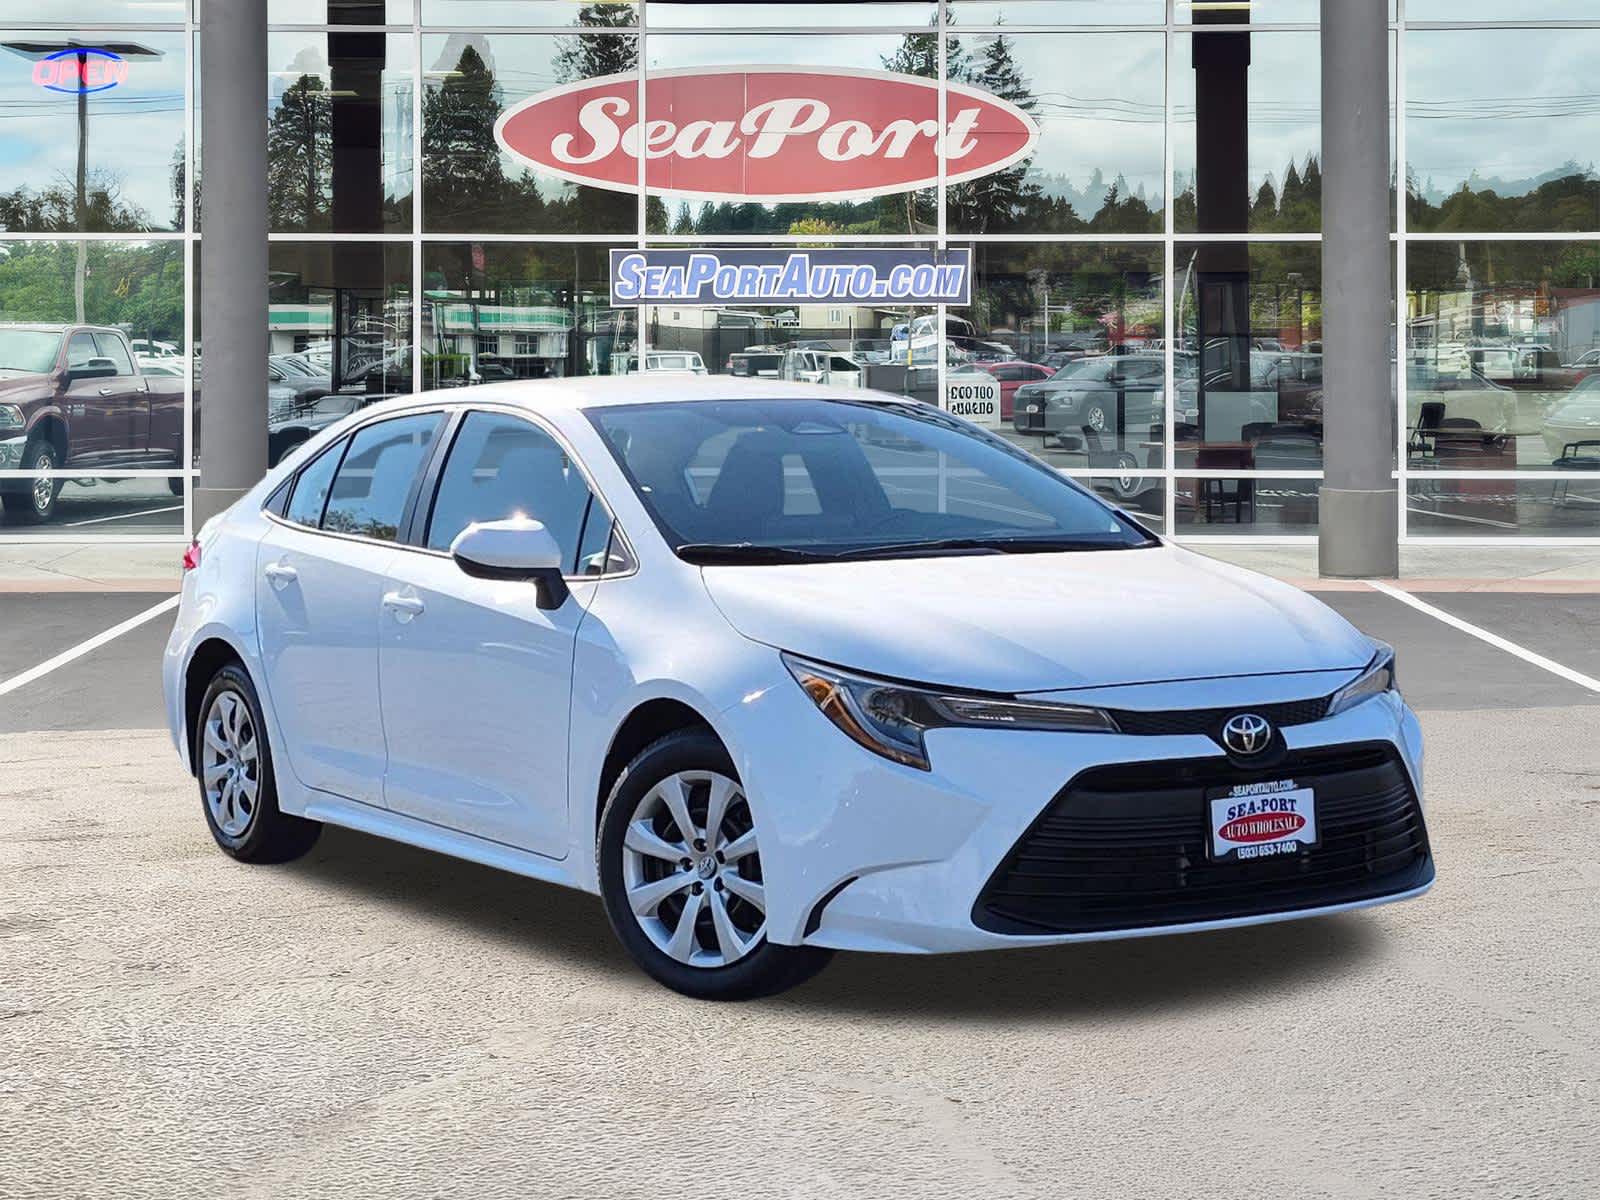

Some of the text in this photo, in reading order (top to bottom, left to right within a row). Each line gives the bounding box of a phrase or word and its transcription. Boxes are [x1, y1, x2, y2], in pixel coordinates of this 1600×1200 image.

[32, 60, 128, 86] OPEN
[551, 96, 982, 165] SeaPort
[1225, 815, 1299, 839] AUTO WHOLESALE
